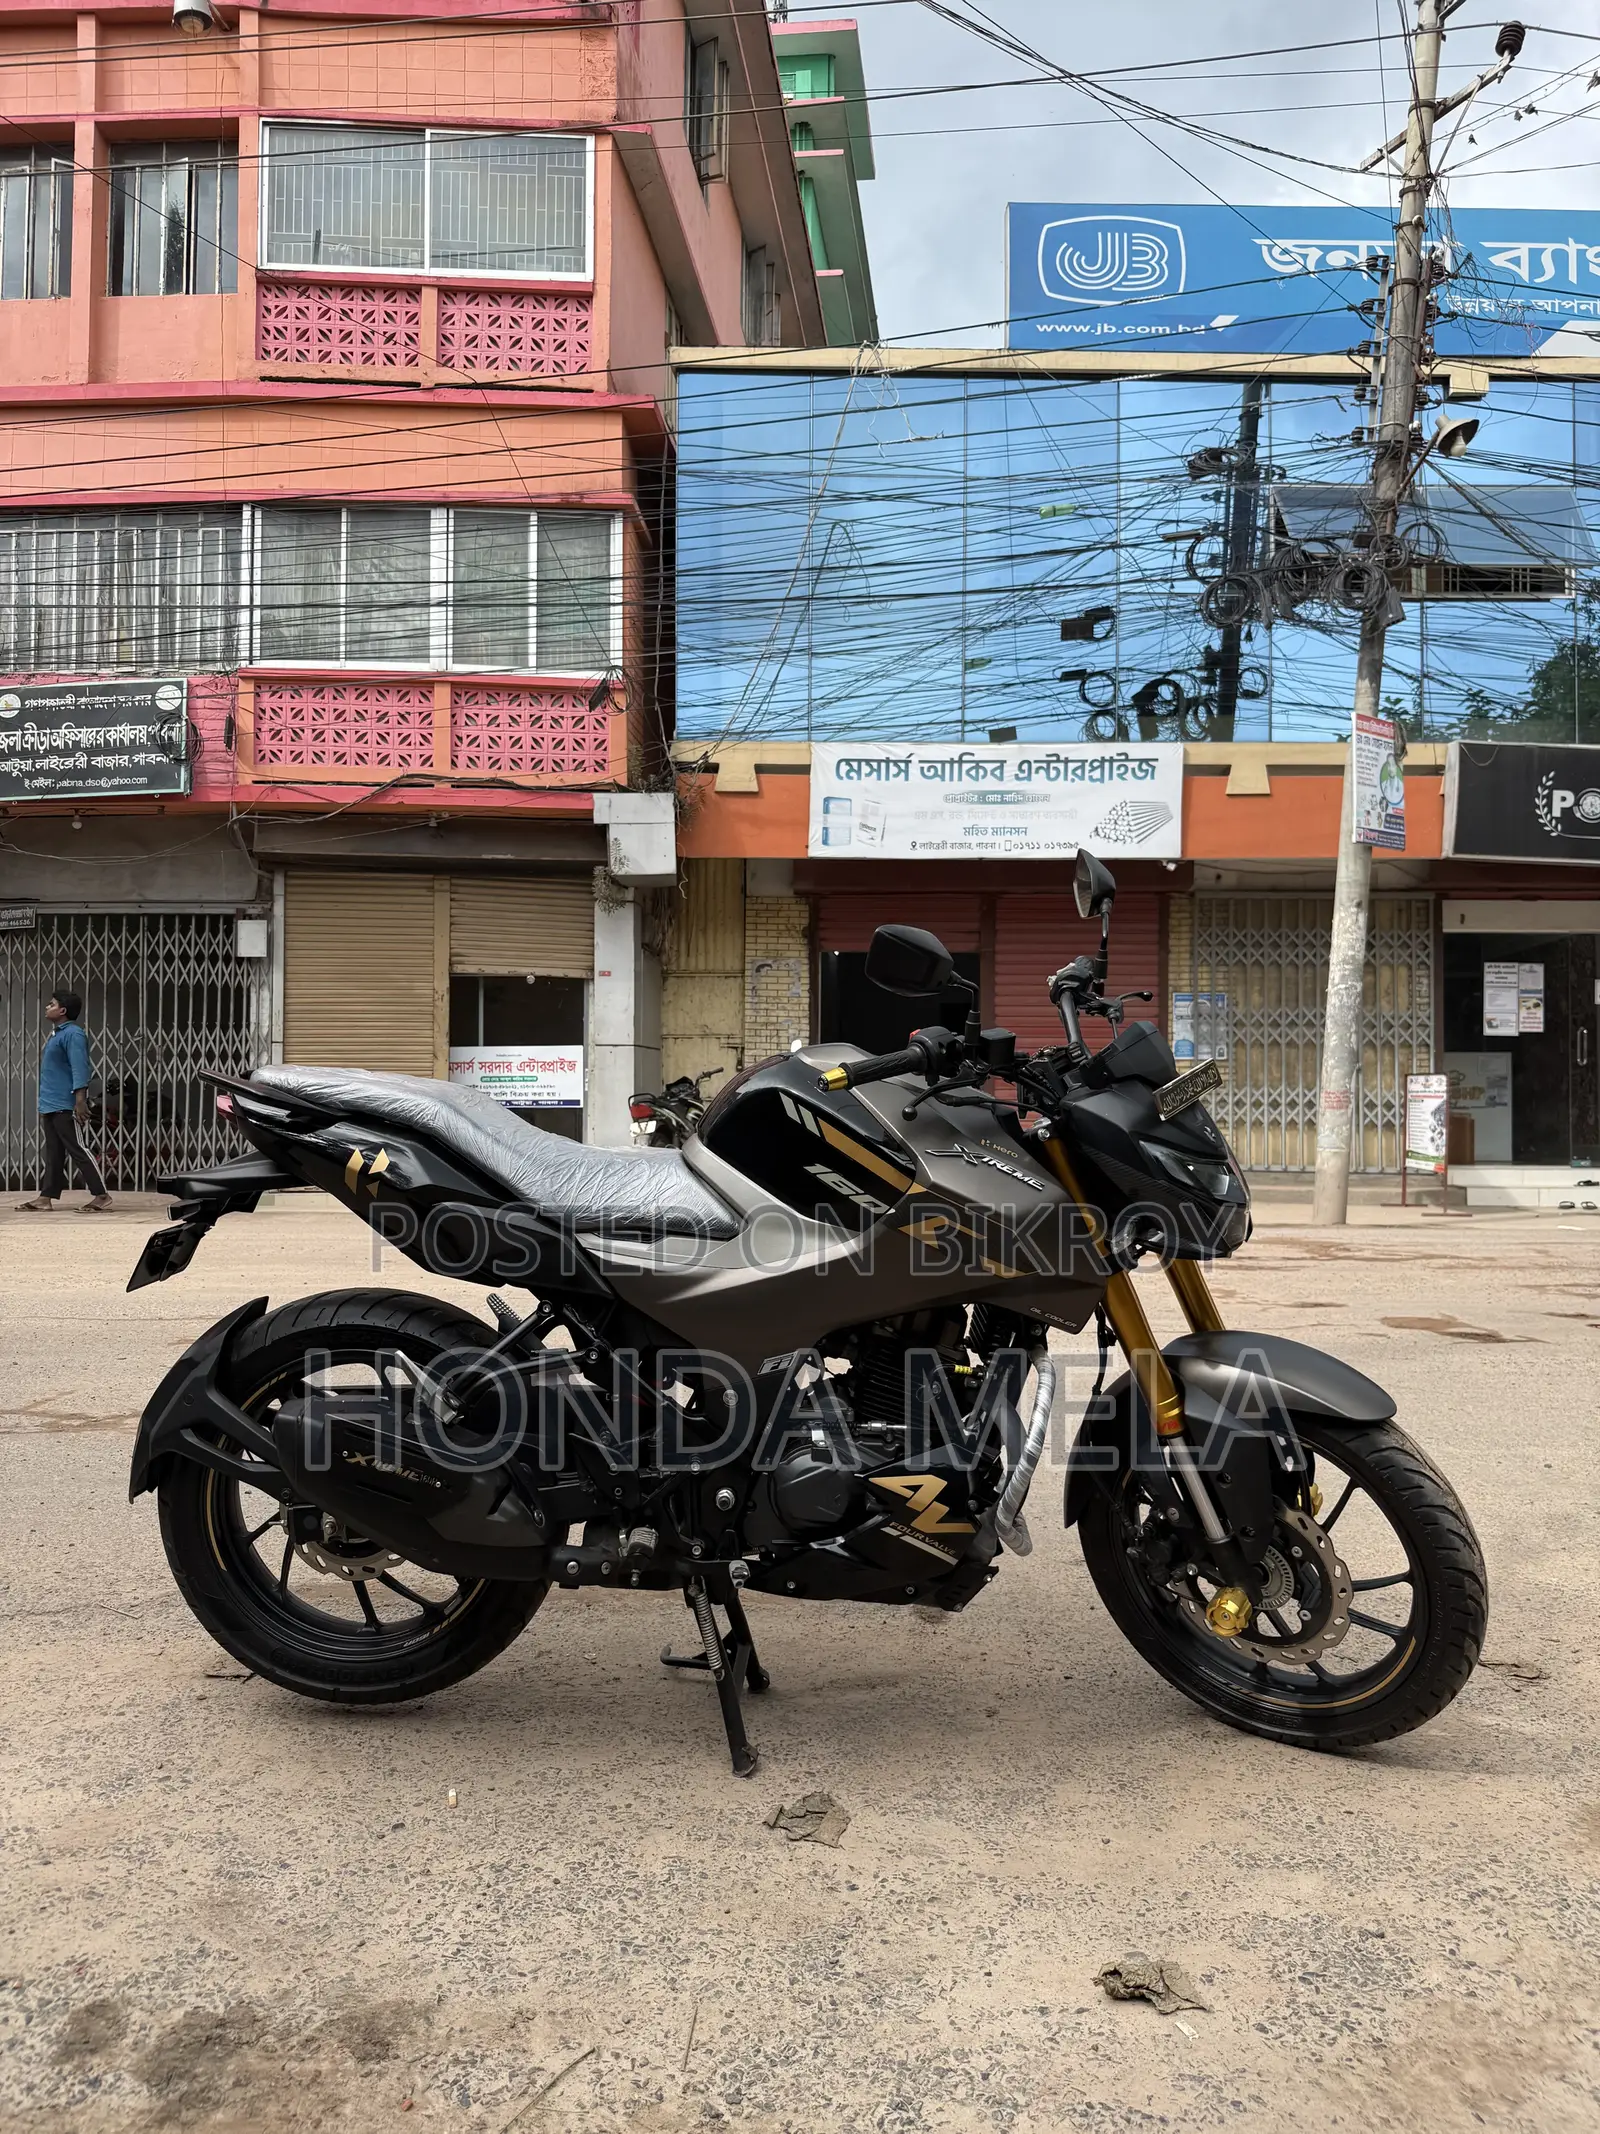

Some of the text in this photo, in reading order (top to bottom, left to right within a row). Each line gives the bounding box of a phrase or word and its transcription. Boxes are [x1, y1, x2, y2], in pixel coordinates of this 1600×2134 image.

[1251, 235, 1466, 284] জনা
[1036, 322, 1206, 335] www.jb.com.bd
[50, 722, 105, 750] অফিসারের
[835, 752, 1159, 784] মেসার্স আকিব এন্টারপ্রাইজ
[56, 776, 148, 790] pabna.dso@yahoo.com
[963, 824, 1028, 837] মহিত ম্যানসন
[449, 1057, 577, 1074] সার্স সরদার এন্টারপ্রাইজ
[925, 1143, 1045, 1191] XTREME
[1044, 1313, 1077, 1327] COOLER
